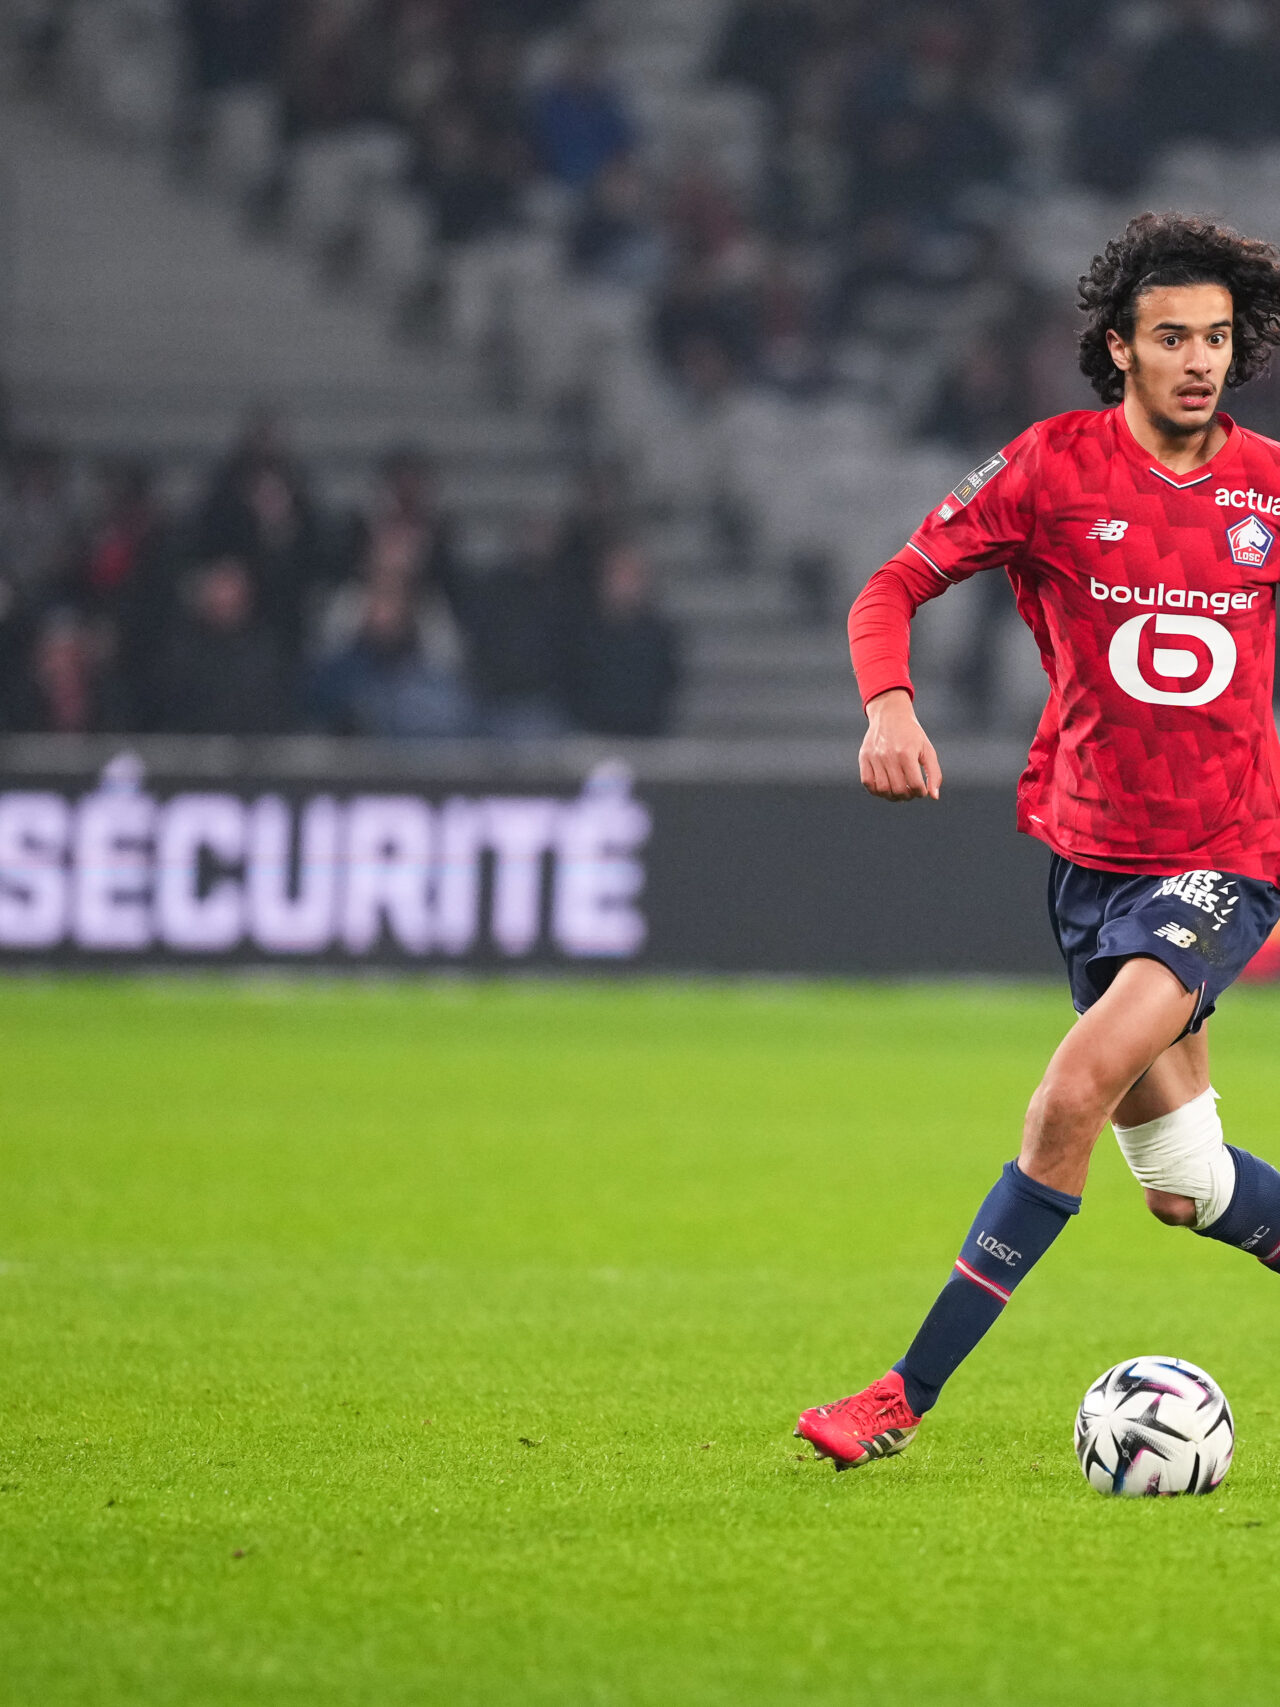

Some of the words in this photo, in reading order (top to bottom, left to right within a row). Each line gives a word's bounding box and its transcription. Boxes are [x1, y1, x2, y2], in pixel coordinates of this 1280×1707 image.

[1237, 551, 1261, 562] LOSC
[1090, 577, 1259, 614] boulanger
[0, 751, 651, 957] SÉCURITÉ
[976, 1230, 1022, 1266] LOSC
